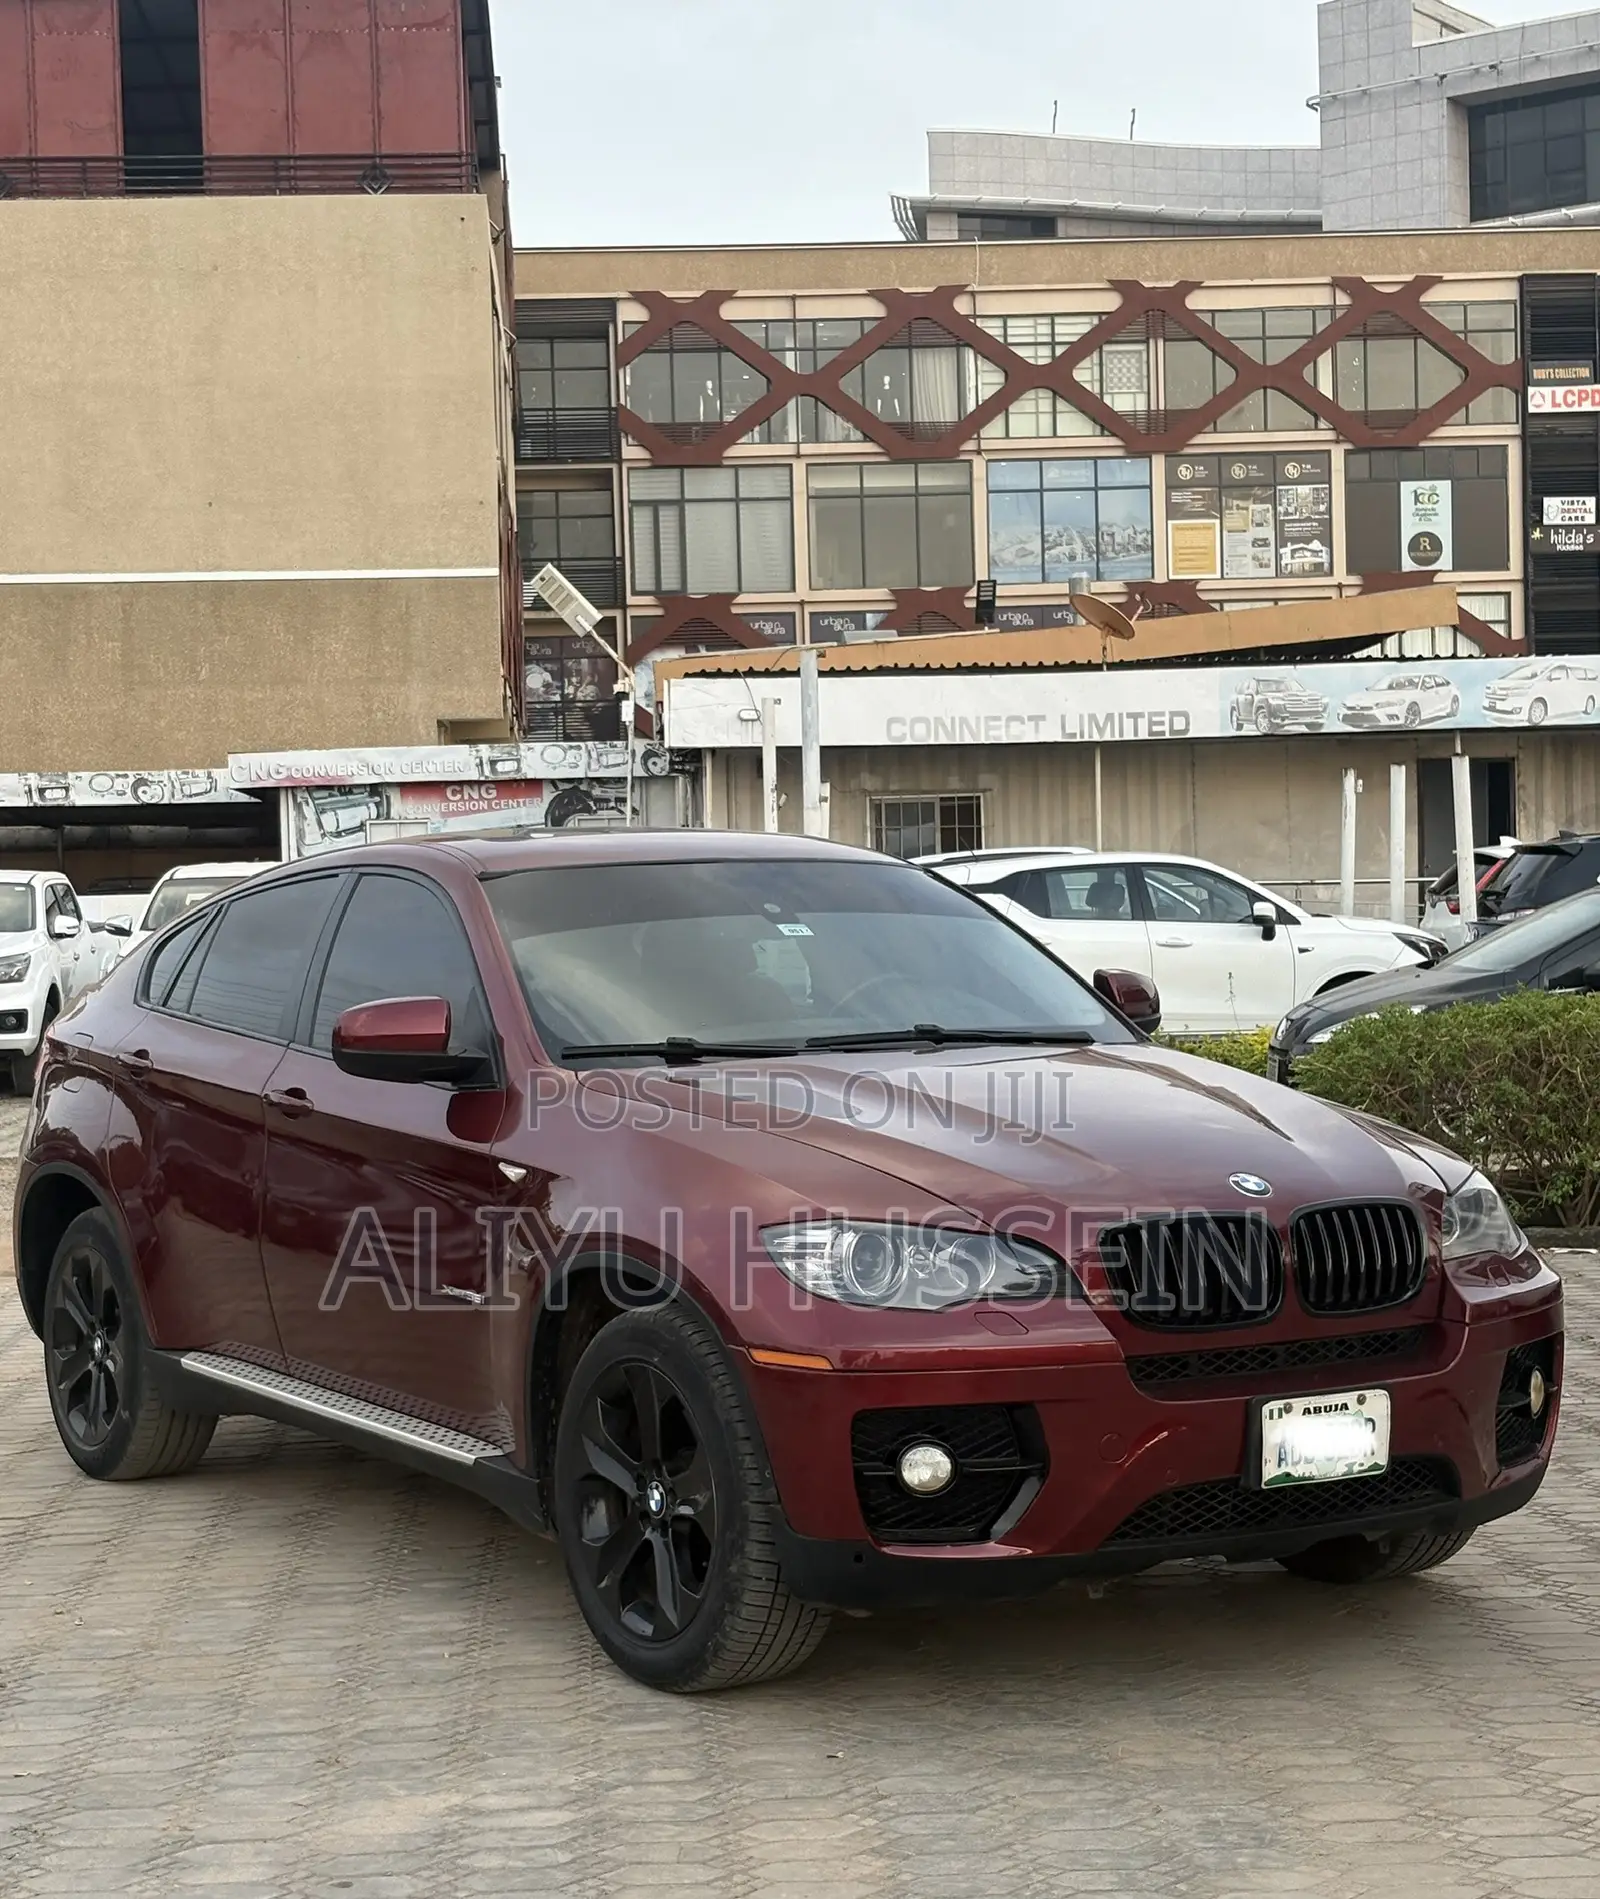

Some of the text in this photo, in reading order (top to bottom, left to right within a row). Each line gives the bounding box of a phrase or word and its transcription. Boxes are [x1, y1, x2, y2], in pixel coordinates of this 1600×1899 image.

[1555, 367, 1590, 379] COLLECTION
[1550, 528, 1595, 544] hilda's
[1419, 537, 1432, 551] R
[820, 616, 850, 626] urban
[998, 612, 1029, 621] urban
[750, 620, 781, 630] urban
[763, 626, 786, 635] aura
[833, 623, 855, 632] aura
[886, 710, 1191, 743] CONNECT LIMITED
[230, 759, 464, 783] CNG CONVERSION CENTER
[446, 783, 497, 801] CNG
[406, 797, 541, 814] CONVERSION CENTER
[1302, 1403, 1349, 1416] ABUJA
